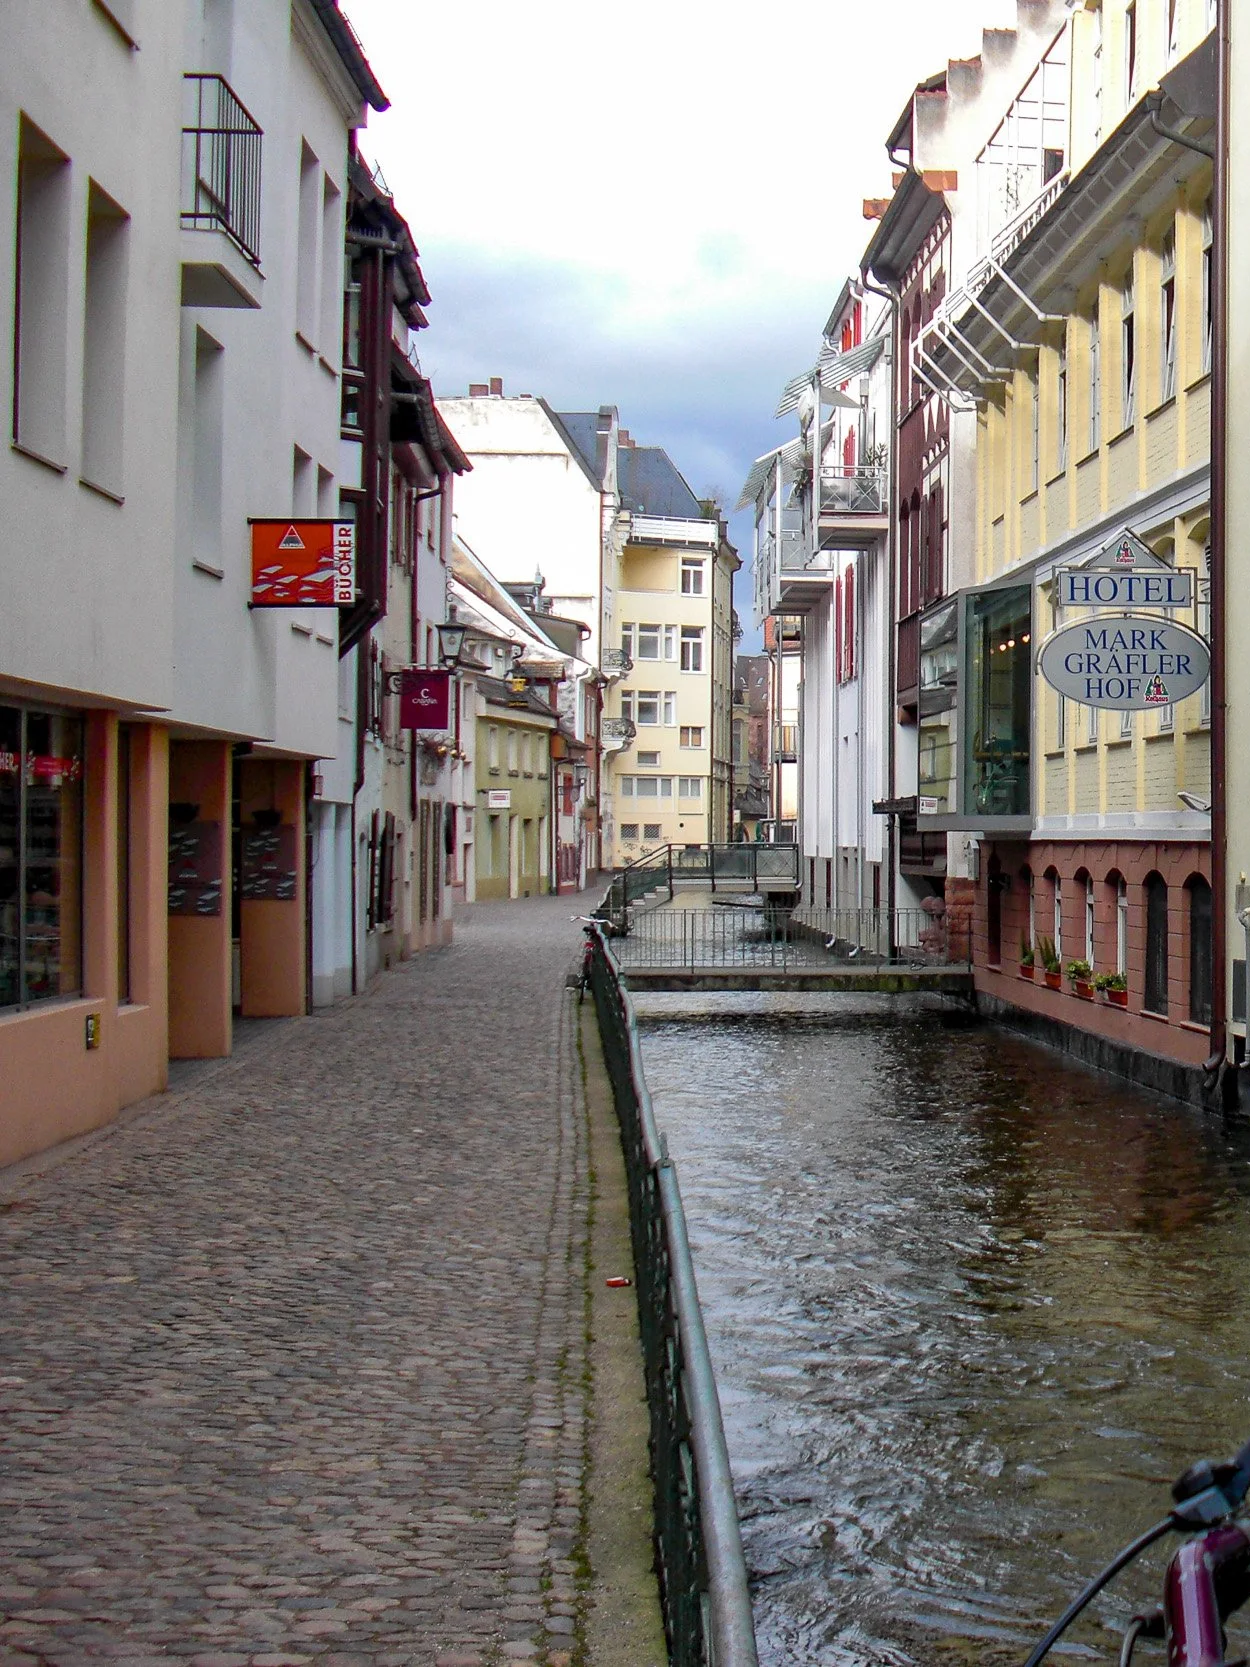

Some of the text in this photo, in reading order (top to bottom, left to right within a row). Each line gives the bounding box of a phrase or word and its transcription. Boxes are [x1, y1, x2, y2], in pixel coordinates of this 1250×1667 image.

[336, 527, 353, 601] BÜCHER
[1068, 575, 1186, 603] HOTEL
[1085, 629, 1167, 650] MARK
[1064, 648, 1193, 675] GRÄFLER
[1085, 677, 1141, 699] HOF
